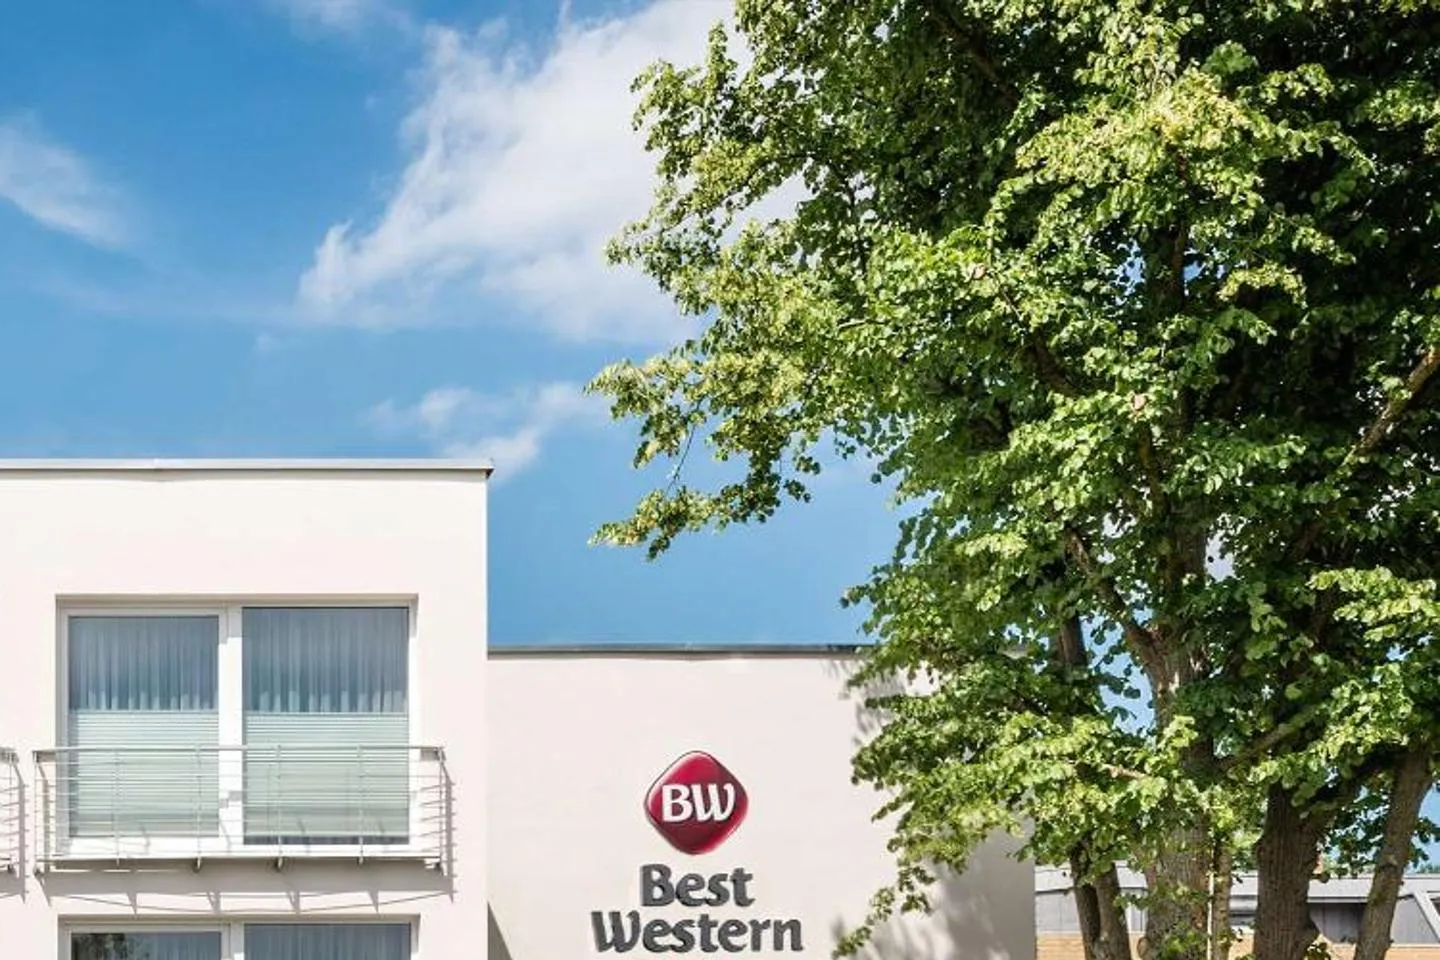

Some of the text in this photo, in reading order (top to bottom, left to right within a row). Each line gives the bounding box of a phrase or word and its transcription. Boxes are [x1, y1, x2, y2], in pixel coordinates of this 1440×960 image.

[661, 783, 736, 822] BW
[640, 864, 755, 907] Best
[591, 911, 803, 953] Western
